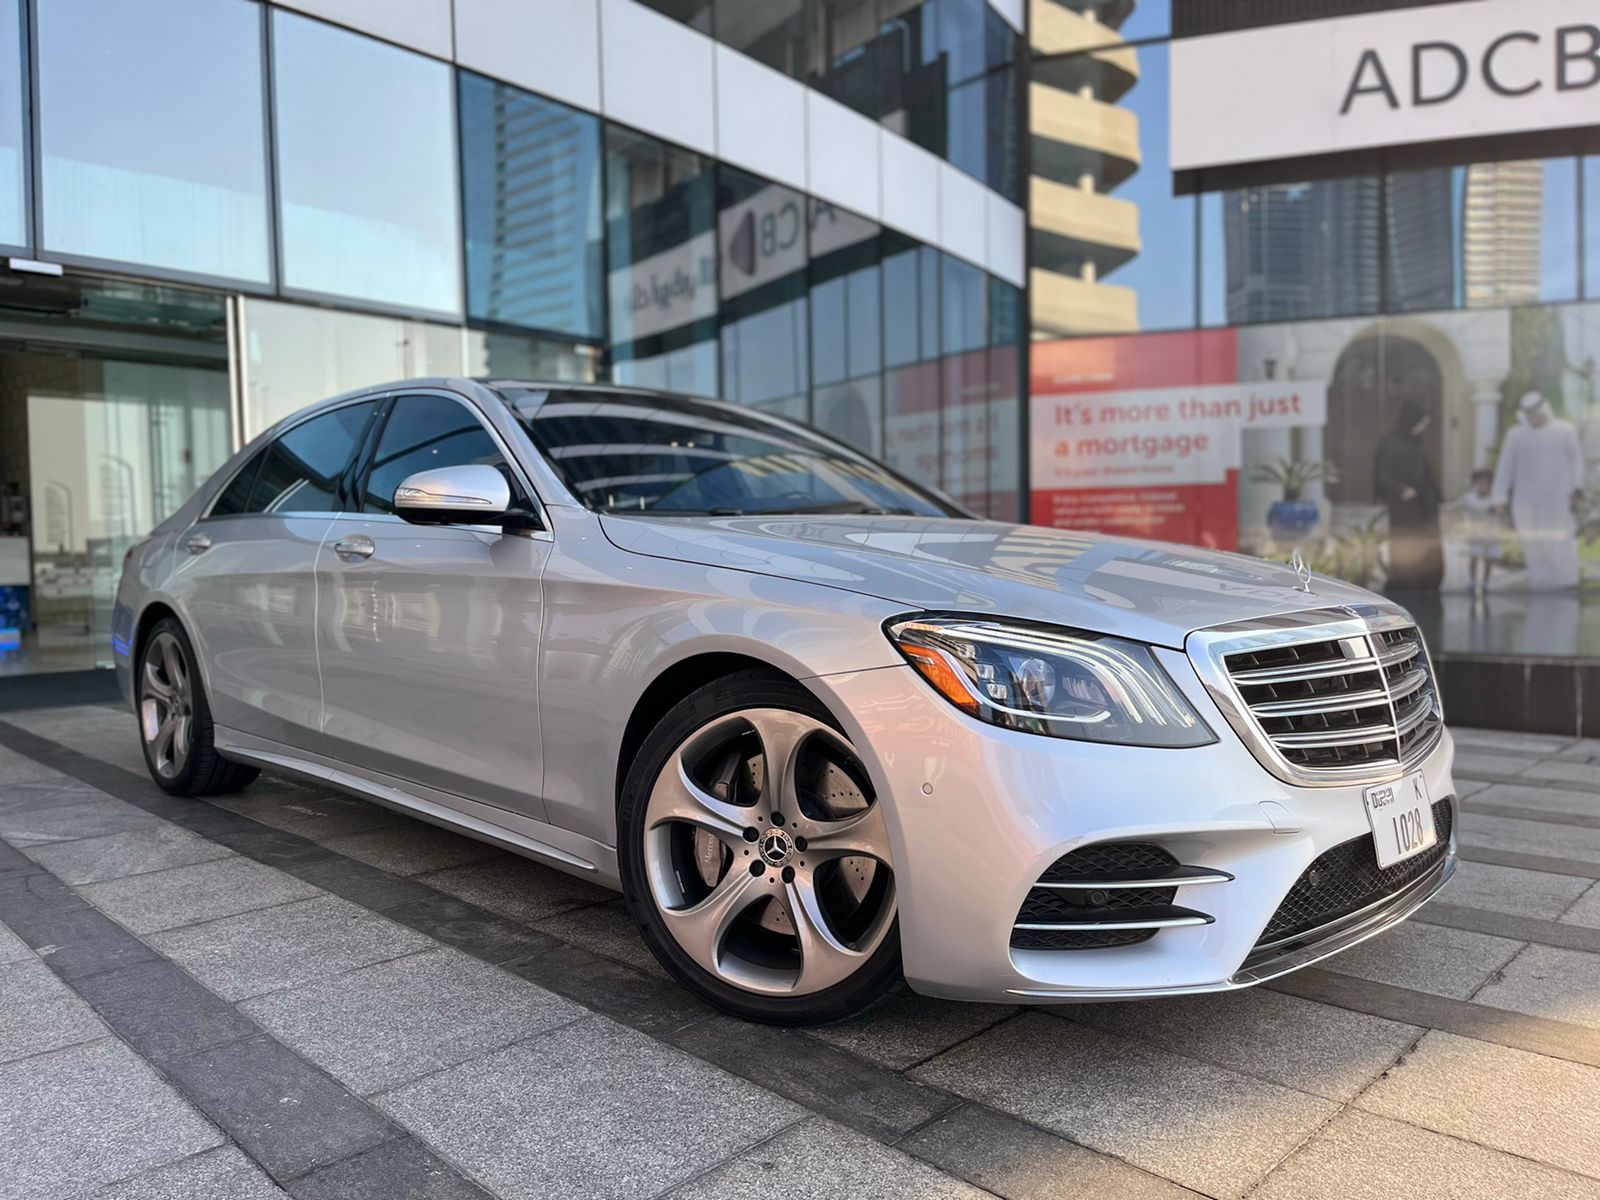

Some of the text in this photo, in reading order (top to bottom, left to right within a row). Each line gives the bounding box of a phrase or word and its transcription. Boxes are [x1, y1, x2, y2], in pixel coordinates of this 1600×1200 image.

[1338, 23, 1600, 116] ADCB
[1054, 392, 1302, 426] It's more than just
[1054, 431, 1210, 458] a mortgage
[1413, 778, 1422, 800] K
[1393, 808, 1423, 854] 1028
